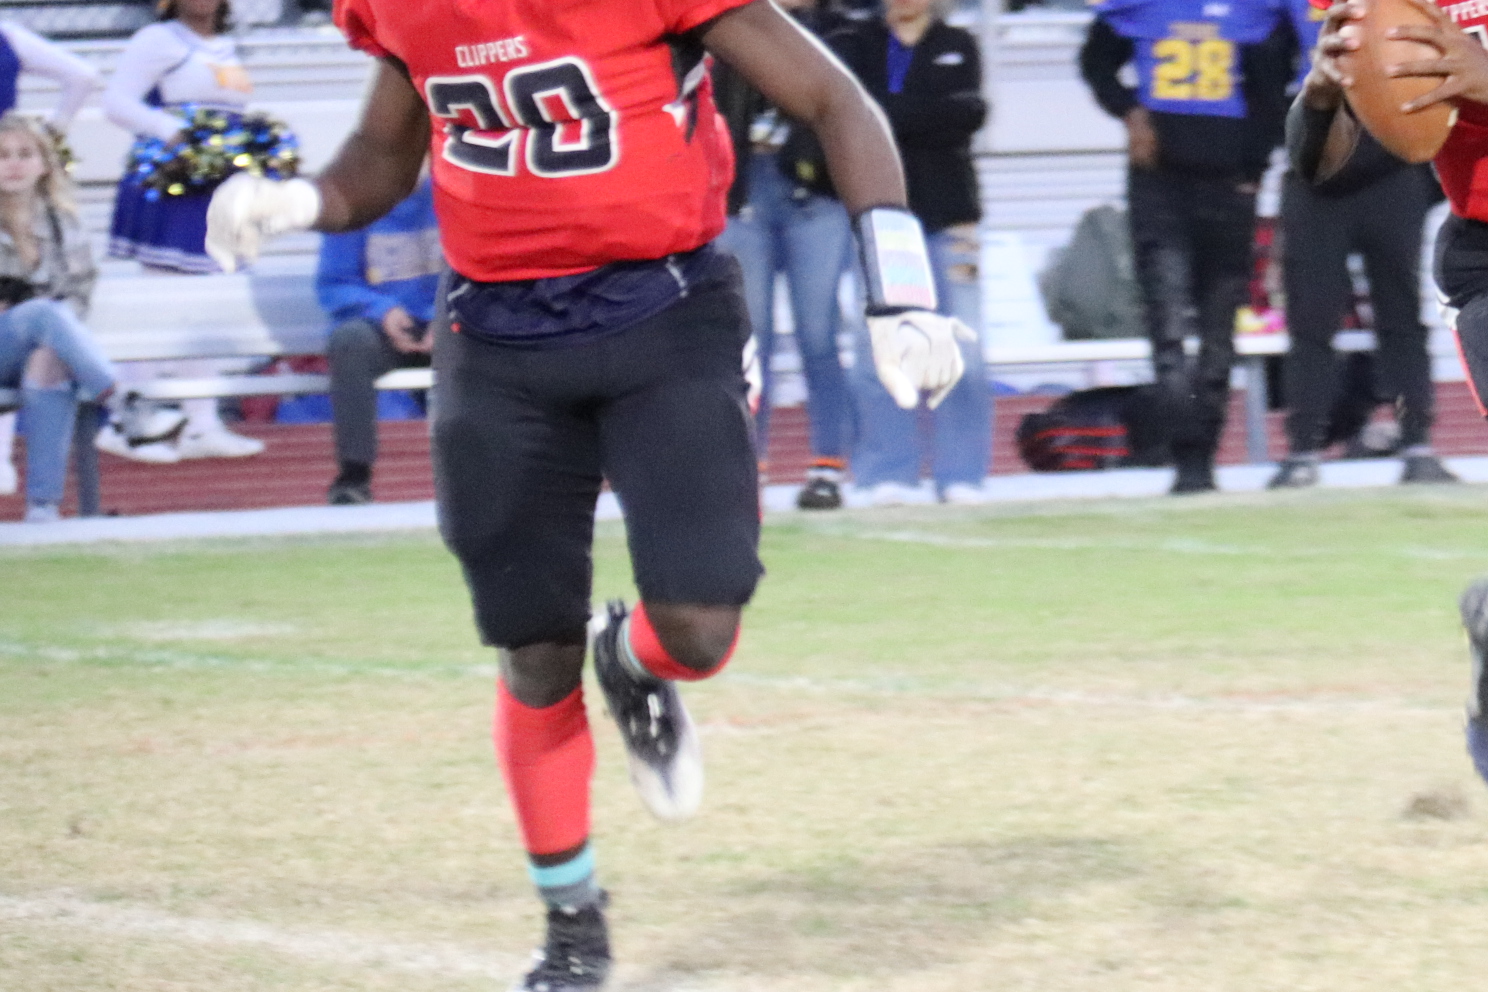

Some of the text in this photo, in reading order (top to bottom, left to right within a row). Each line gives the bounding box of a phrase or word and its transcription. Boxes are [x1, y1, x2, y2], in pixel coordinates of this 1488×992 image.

[454, 35, 529, 68] CLIPPERS
[1152, 38, 1237, 101] 28
[424, 55, 619, 179] 20
